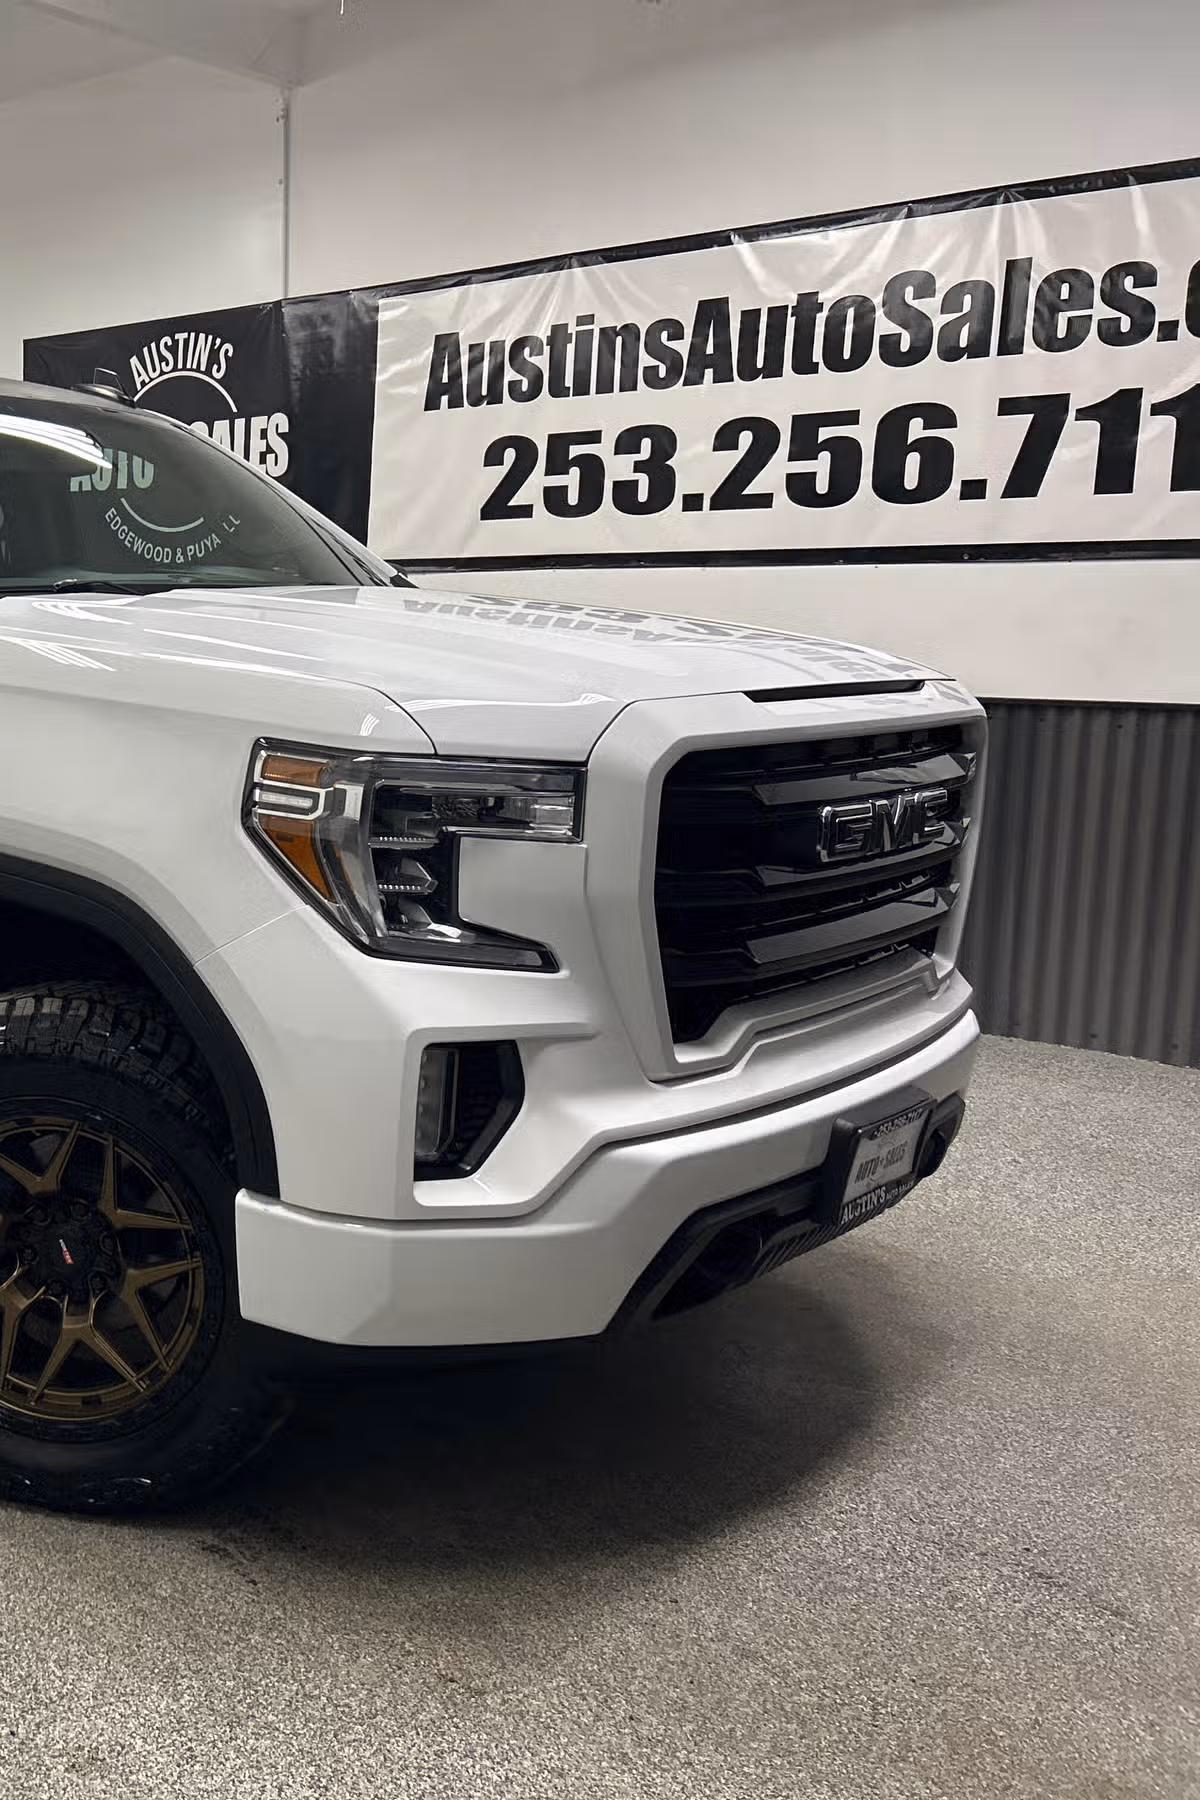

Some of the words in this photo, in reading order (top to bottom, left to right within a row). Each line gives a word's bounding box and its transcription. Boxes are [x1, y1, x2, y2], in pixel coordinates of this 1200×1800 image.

[129, 332, 234, 392] AUSTIN'S
[104, 507, 173, 563] EDGEWOOD
[175, 547, 185, 564] &
[817, 787, 948, 862] GMC
[841, 1185, 886, 1224] AUSTIN'S
